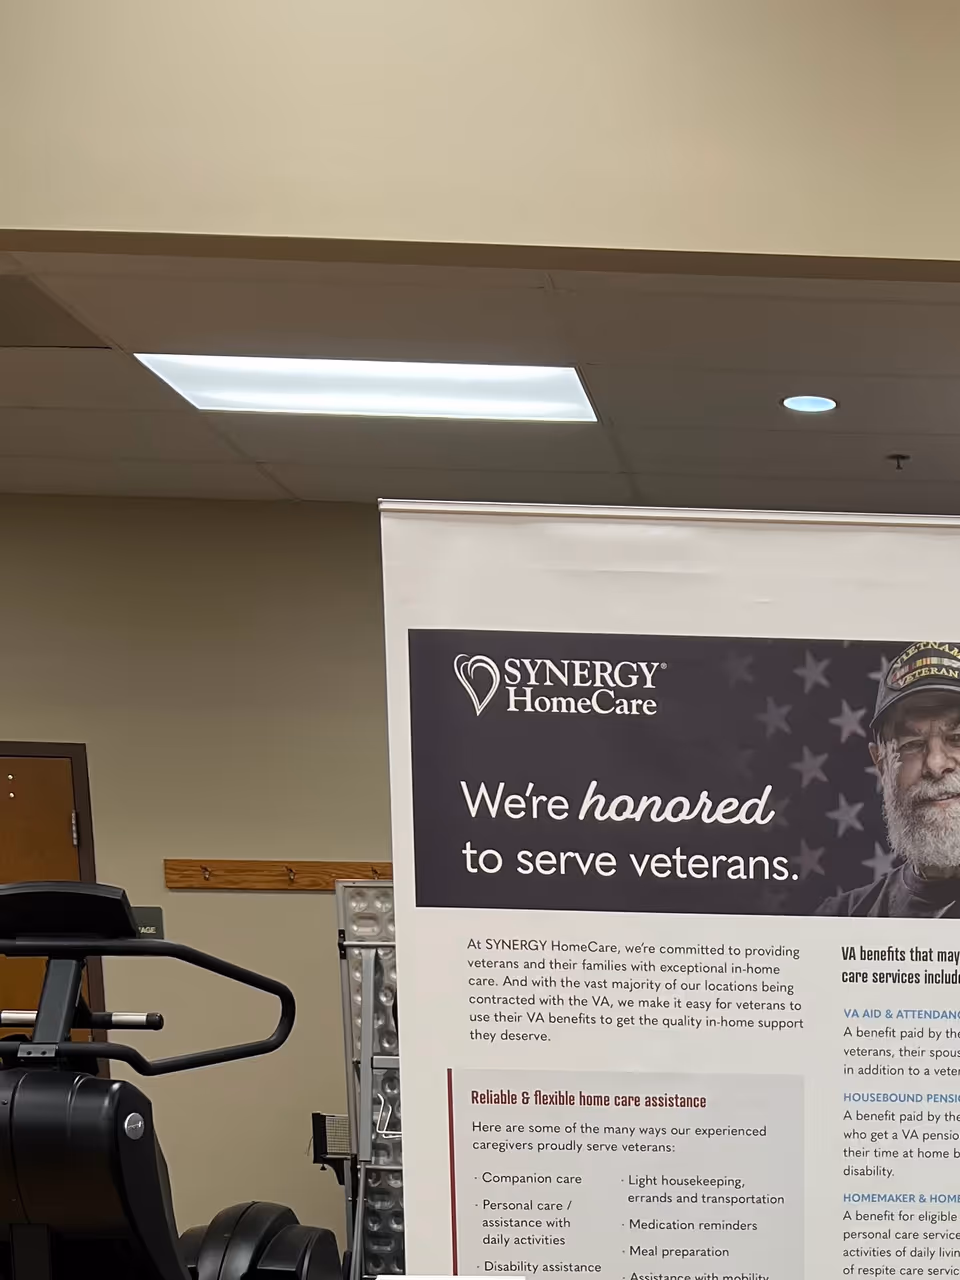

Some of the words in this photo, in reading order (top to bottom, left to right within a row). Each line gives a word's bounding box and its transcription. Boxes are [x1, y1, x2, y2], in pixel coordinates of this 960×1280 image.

[898, 667, 959, 687] VETERAN
[506, 687, 657, 715] HomeCare
[460, 780, 569, 818] We're
[579, 780, 775, 824] honored
[462, 841, 503, 873] to
[516, 850, 617, 876] serve
[629, 847, 798, 881] veterans.
[467, 937, 481, 950] At
[485, 937, 547, 951] SYNERGY
[551, 939, 621, 954] HomeCare,
[625, 941, 655, 954] we're
[659, 943, 725, 955] committed
[728, 945, 741, 956] to
[745, 944, 800, 960] providing
[841, 946, 856, 961] VA
[860, 944, 906, 961] benefits
[909, 945, 933, 962] that
[937, 950, 960, 966] may
[468, 958, 519, 969] veterans
[523, 957, 545, 969] and
[549, 957, 578, 970] their
[582, 958, 627, 972] families
[631, 959, 655, 972] with
[660, 961, 727, 975] exceptional
[731, 962, 780, 974] in-home
[842, 970, 868, 983] care
[872, 968, 920, 984] services
[844, 1008, 859, 1018] VA
[862, 1008, 881, 1018] AID
[885, 1008, 893, 1019] &
[470, 1028, 496, 1043] they
[500, 1028, 551, 1041] deserve.
[844, 1046, 894, 1058] veterans,
[899, 1045, 926, 1057] their
[471, 1088, 517, 1104] Reliable
[521, 1090, 530, 1105] &
[534, 1089, 575, 1106] flexible
[579, 1090, 610, 1106] home
[614, 1095, 640, 1107] care
[645, 1092, 706, 1108] assistance
[844, 1092, 923, 1103] HOUSEBOUND
[473, 1138, 533, 1153] caregivers
[537, 1139, 583, 1153] proudly
[586, 1142, 618, 1151] serve
[622, 1142, 675, 1152] veterans:
[482, 1171, 552, 1185] Companion
[556, 1175, 582, 1184] care
[843, 1164, 894, 1178] disability.
[629, 1174, 657, 1188] Light
[661, 1174, 745, 1189] housekeeping,
[483, 1198, 533, 1210] Personal
[537, 1202, 563, 1211] care
[567, 1200, 572, 1210] /
[628, 1191, 672, 1203] errands
[676, 1191, 698, 1203] and
[701, 1193, 784, 1206] transportation
[844, 1192, 916, 1203] HOMEMAKER
[919, 1193, 926, 1203] &
[482, 1216, 542, 1228] assistance
[546, 1216, 570, 1228] with
[629, 1218, 695, 1230] Medication
[699, 1219, 758, 1231] reminders
[483, 1233, 510, 1247] daily
[514, 1233, 565, 1245] activities
[843, 1228, 891, 1241] personal
[895, 1231, 919, 1240] care
[630, 1244, 657, 1256] Meal
[662, 1245, 729, 1259] preparation
[843, 1246, 892, 1257] activities
[895, 1245, 907, 1257] of
[910, 1246, 936, 1260] daily
[484, 1260, 539, 1274] Disability
[542, 1261, 601, 1272] assistance
